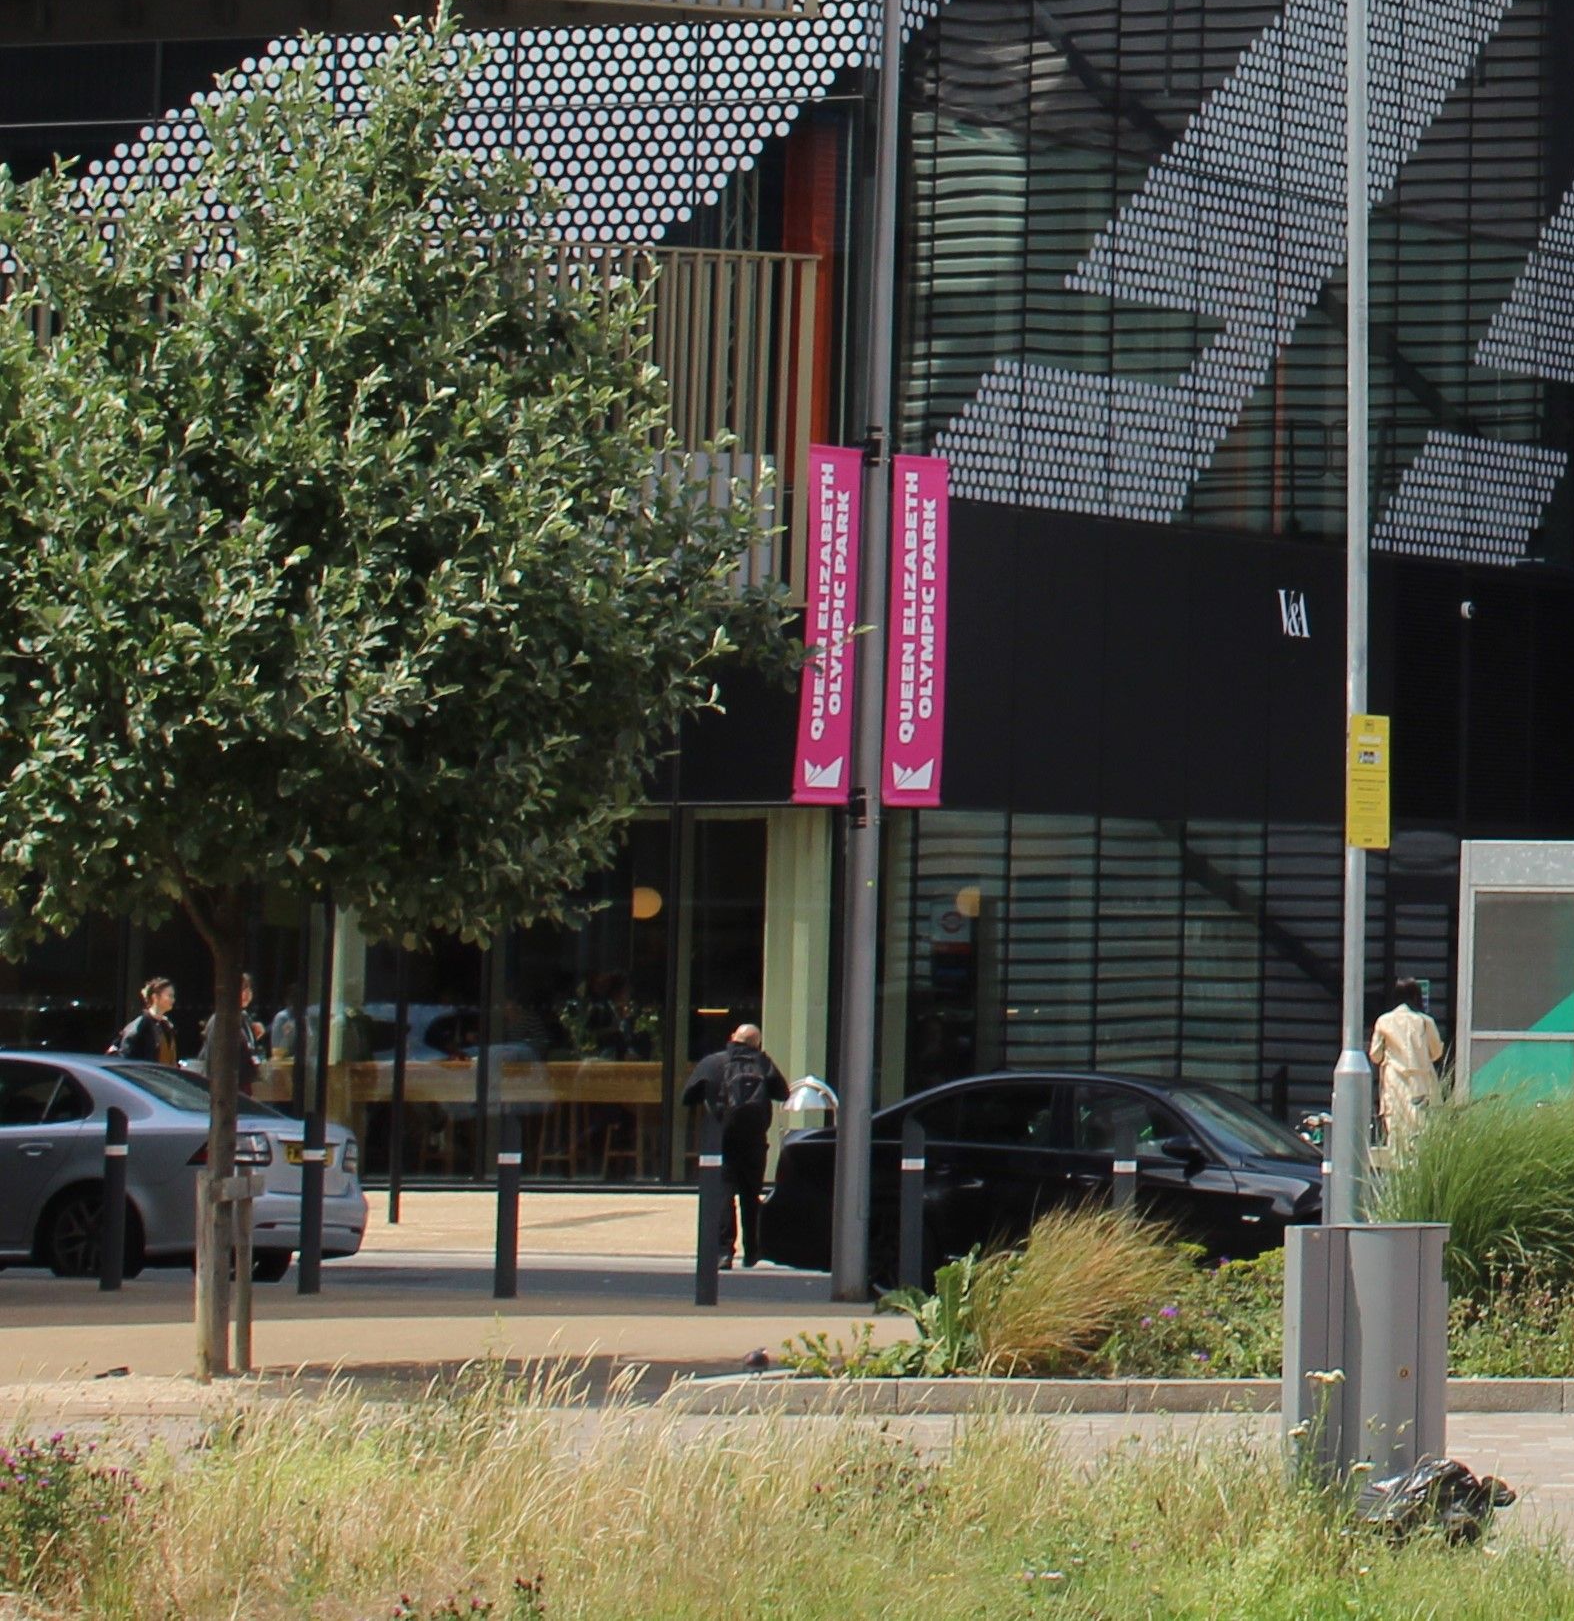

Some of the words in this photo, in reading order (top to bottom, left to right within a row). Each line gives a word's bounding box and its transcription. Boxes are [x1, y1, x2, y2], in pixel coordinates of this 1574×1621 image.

[817, 463, 835, 630] ELIZABETH
[834, 490, 850, 574] PARK
[902, 472, 919, 636] ELIZABETH
[922, 498, 937, 581] PARK
[828, 580, 847, 716] OLYMPIC
[918, 586, 936, 720] OLYMPIC
[1278, 589, 1311, 638] V&A
[899, 642, 916, 744] QUEEN
